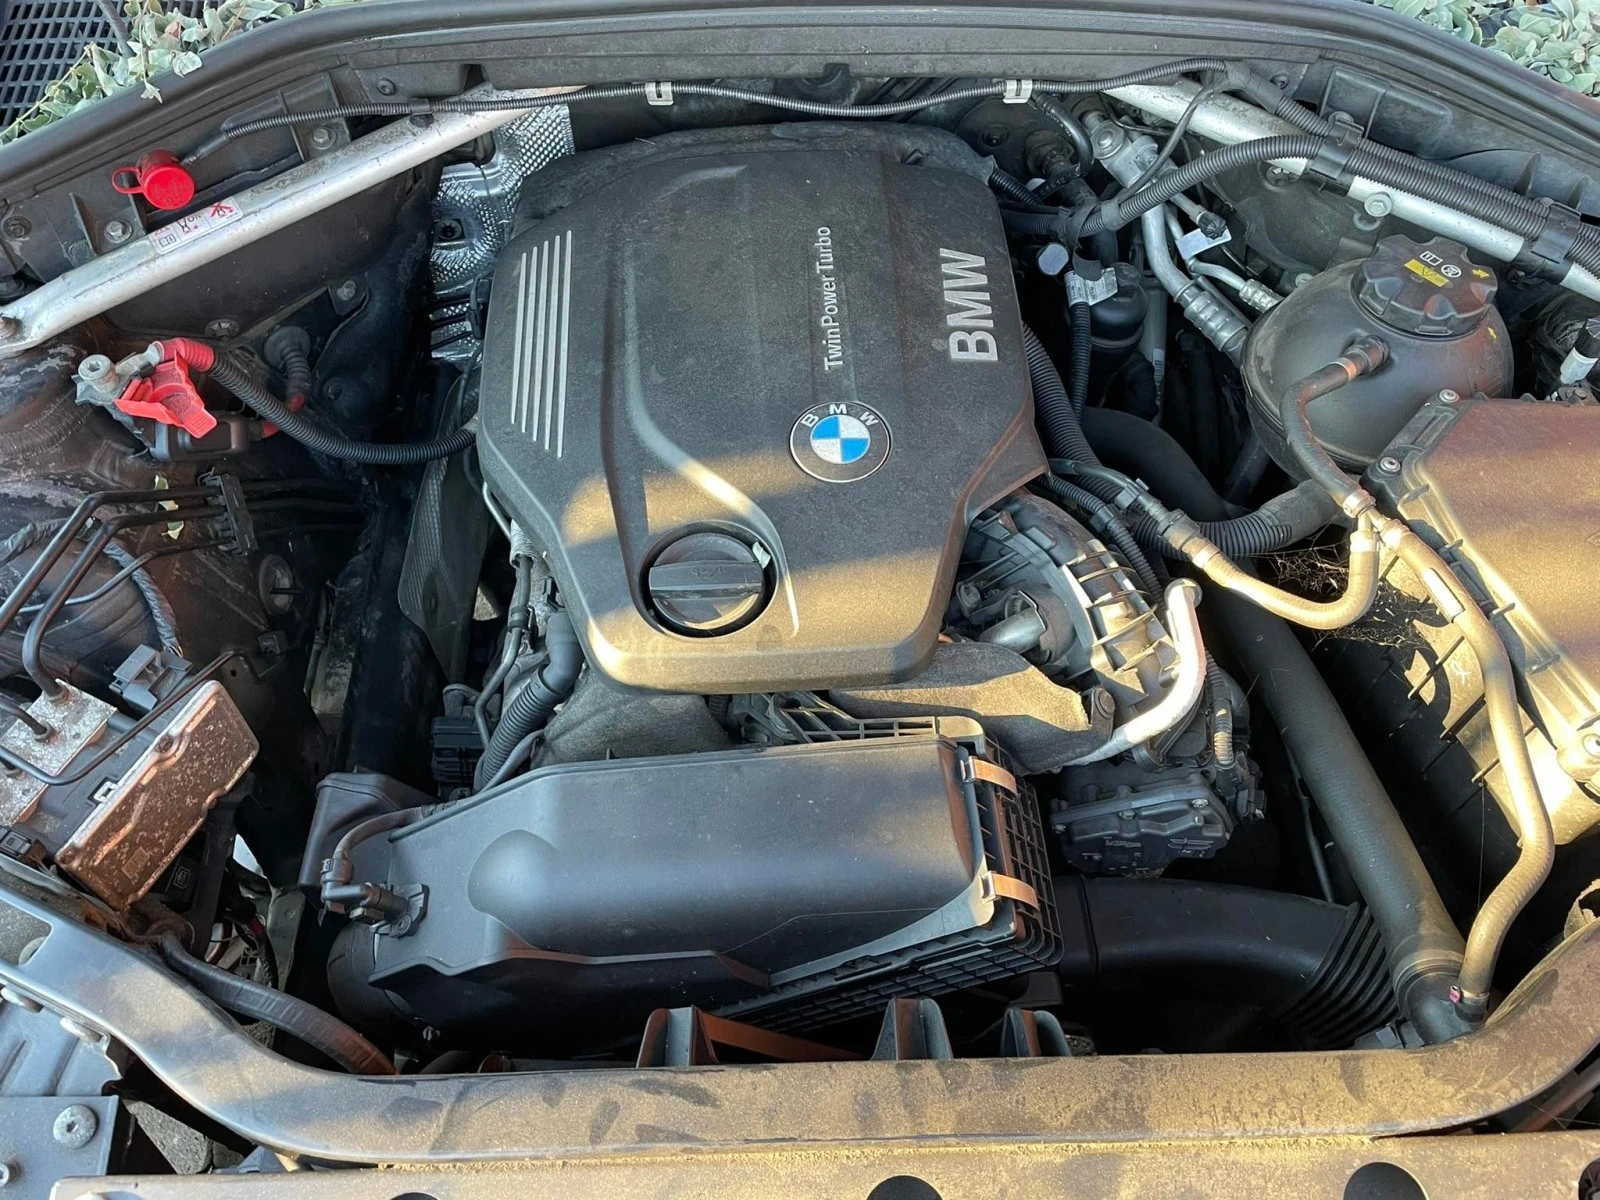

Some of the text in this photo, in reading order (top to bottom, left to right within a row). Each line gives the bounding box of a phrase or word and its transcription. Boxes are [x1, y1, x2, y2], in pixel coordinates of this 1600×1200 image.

[814, 226, 844, 371] TwinPower Turbo
[939, 247, 998, 361] BMW
[800, 403, 879, 428] BMW
